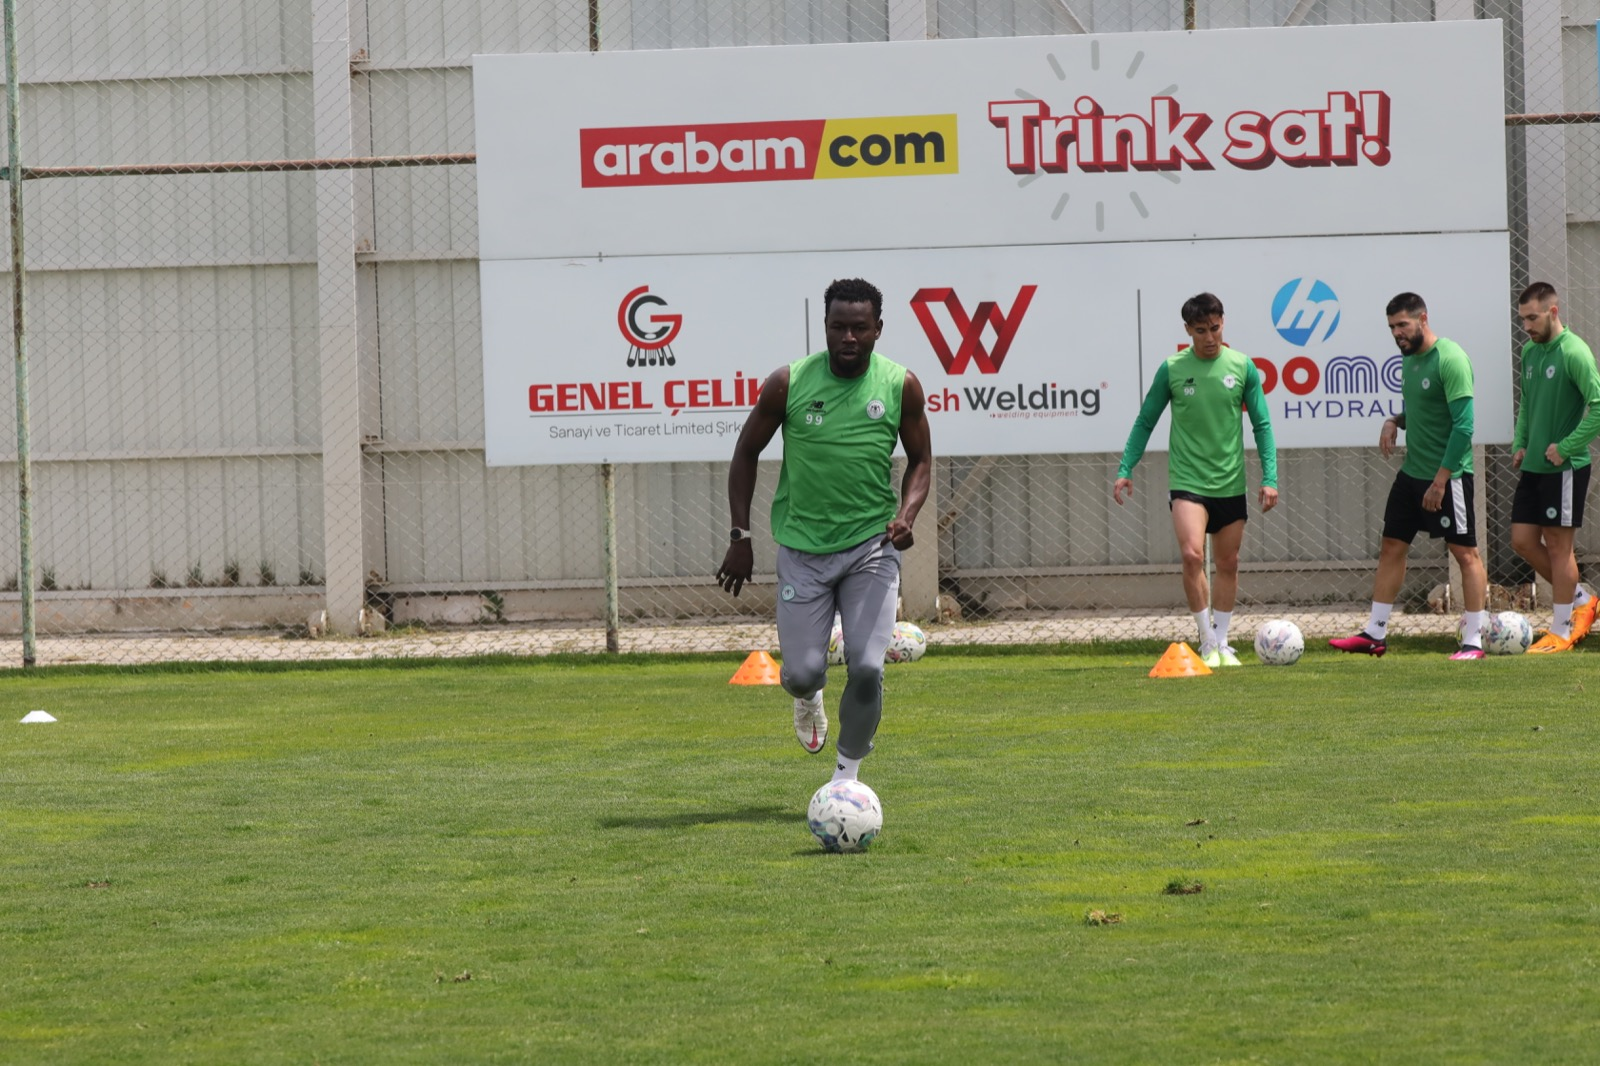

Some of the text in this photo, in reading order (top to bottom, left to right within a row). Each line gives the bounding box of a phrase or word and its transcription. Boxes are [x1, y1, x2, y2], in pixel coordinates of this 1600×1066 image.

[987, 90, 1391, 175] Trink sat!
[593, 130, 946, 177] arabam com
[528, 381, 653, 412] GENEL
[1183, 386, 1196, 397] 90
[805, 413, 823, 426] 99
[997, 410, 1078, 419] welding equipment
[549, 421, 744, 440] Sanayi ve Ticaret Limited Şirk
